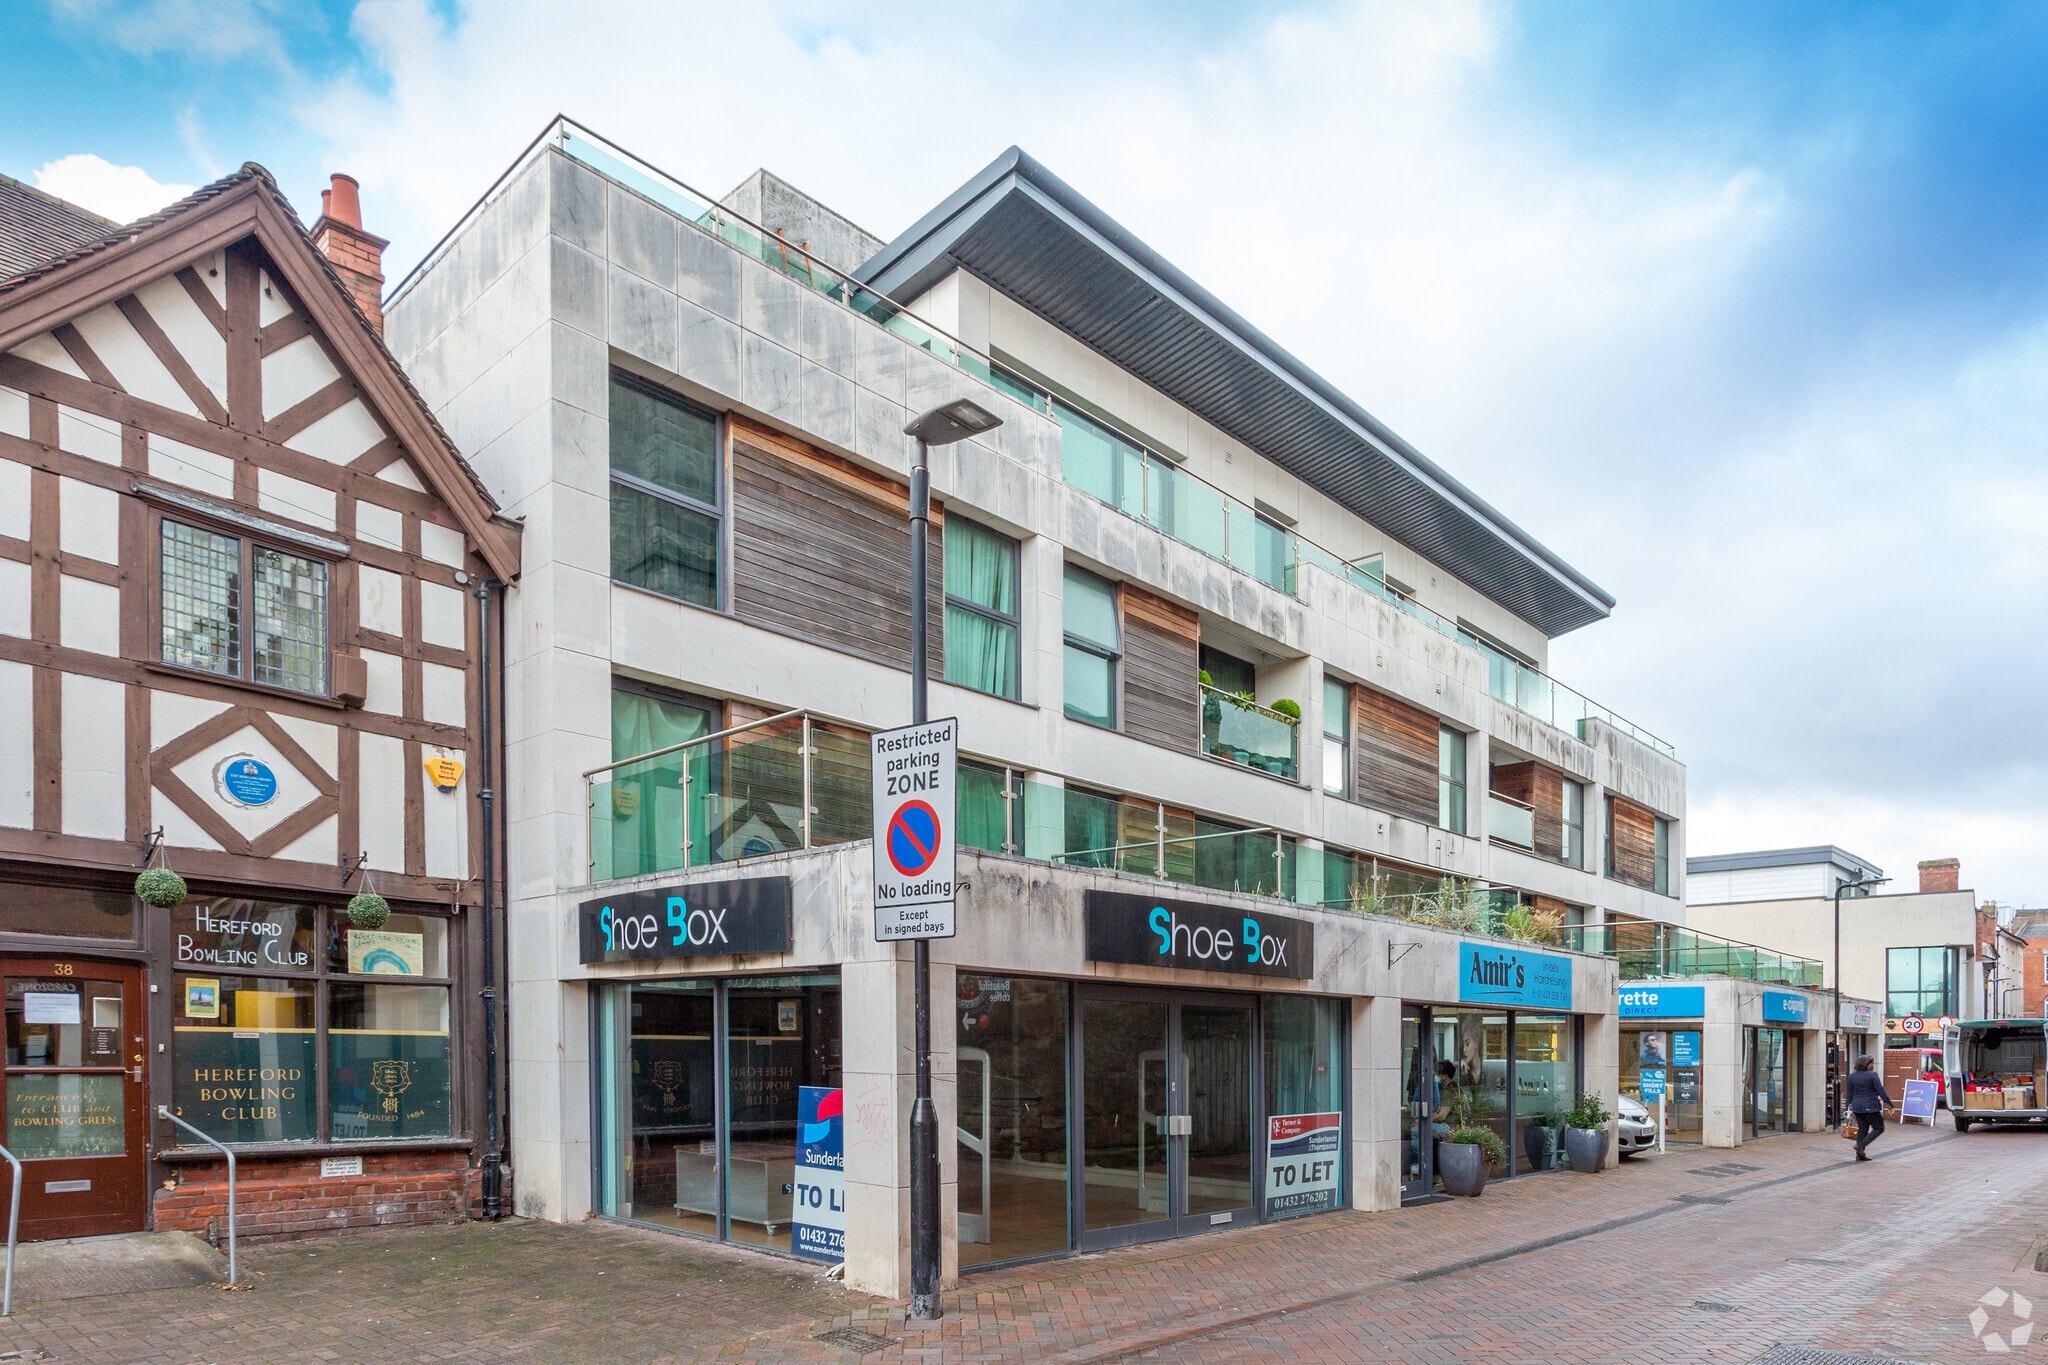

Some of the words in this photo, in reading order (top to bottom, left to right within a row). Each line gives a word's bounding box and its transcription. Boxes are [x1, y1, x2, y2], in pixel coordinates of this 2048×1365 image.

[877, 725, 951, 753] Restricted
[886, 752, 940, 775] parking
[887, 770, 940, 796] ZONE
[878, 883, 896, 900] No
[901, 879, 951, 898] loading
[899, 909, 929, 922] Except
[600, 906, 658, 952] Shoe
[667, 896, 728, 946] Box
[884, 924, 892, 935] in
[894, 922, 922, 936] signed
[924, 920, 944, 934] bays
[1148, 906, 1234, 960] Shoe
[1243, 917, 1288, 967] Box
[54, 964, 74, 976] 38
[1470, 952, 1525, 988] Amir's
[1542, 960, 1559, 972] Unisex
[1534, 972, 1566, 989] Hairdressing
[1905, 1020, 1921, 1029] 20
[194, 1068, 301, 1082] HEREFORD
[16, 1093, 80, 1102] Entrance
[200, 1087, 295, 1101] BOWLING
[21, 1106, 36, 1114] to
[41, 1104, 81, 1114] CLUB
[221, 1106, 277, 1120] CLUB
[357, 1111, 398, 1122] FOUNDED
[406, 1110, 425, 1120] 1484
[14, 1116, 74, 1127] BOWLING
[78, 1116, 117, 1126] GREEN
[1308, 1134, 1338, 1144] Sunderlands
[1273, 1164, 1296, 1188] TO
[1302, 1160, 1334, 1184] LET
[797, 1183, 822, 1208] TO
[1274, 1196, 1298, 1209] 01432
[1300, 1190, 1328, 1206] 276202
[800, 1226, 826, 1244] 01432
